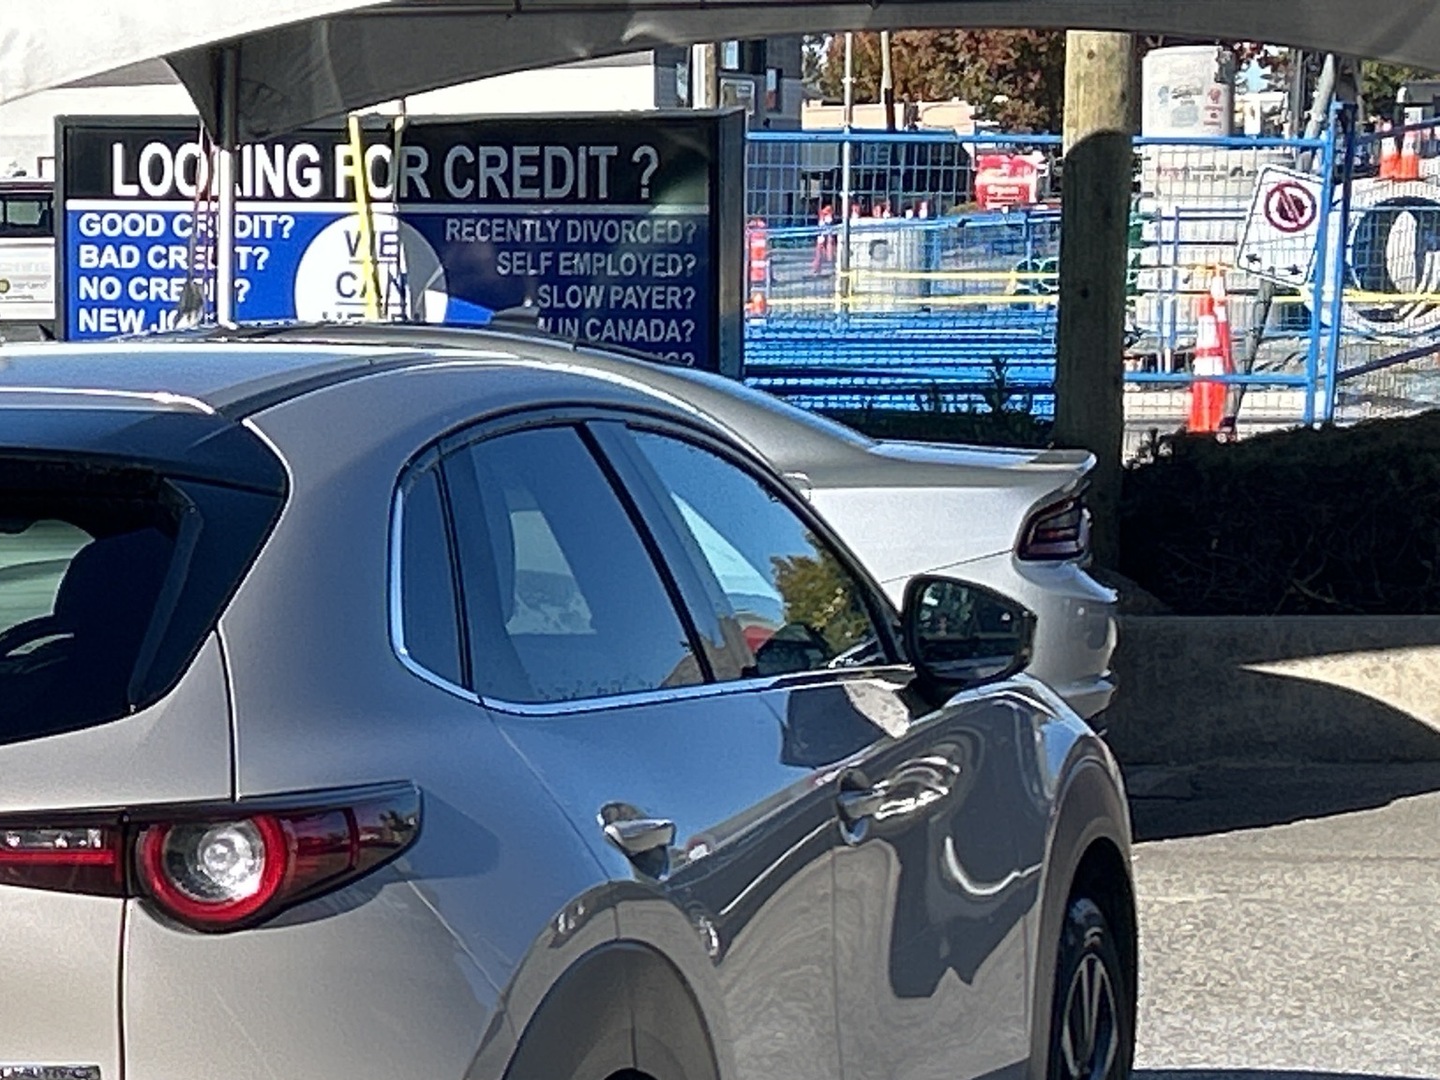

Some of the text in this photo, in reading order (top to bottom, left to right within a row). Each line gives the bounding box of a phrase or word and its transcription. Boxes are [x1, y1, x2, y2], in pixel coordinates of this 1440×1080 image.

[113, 142, 659, 199] LOOING FOR CREDIT ?
[79, 213, 296, 239] GOOD CRDIT?
[445, 218, 697, 244] RECENTLY DIVORCED?
[79, 244, 140, 269] BAD
[496, 251, 697, 278] SELF EMPLOYED?
[79, 276, 122, 301] NO
[537, 284, 696, 310] SLOW PAYER?
[79, 308, 146, 334] NEW
[585, 318, 696, 343] CANADA?
